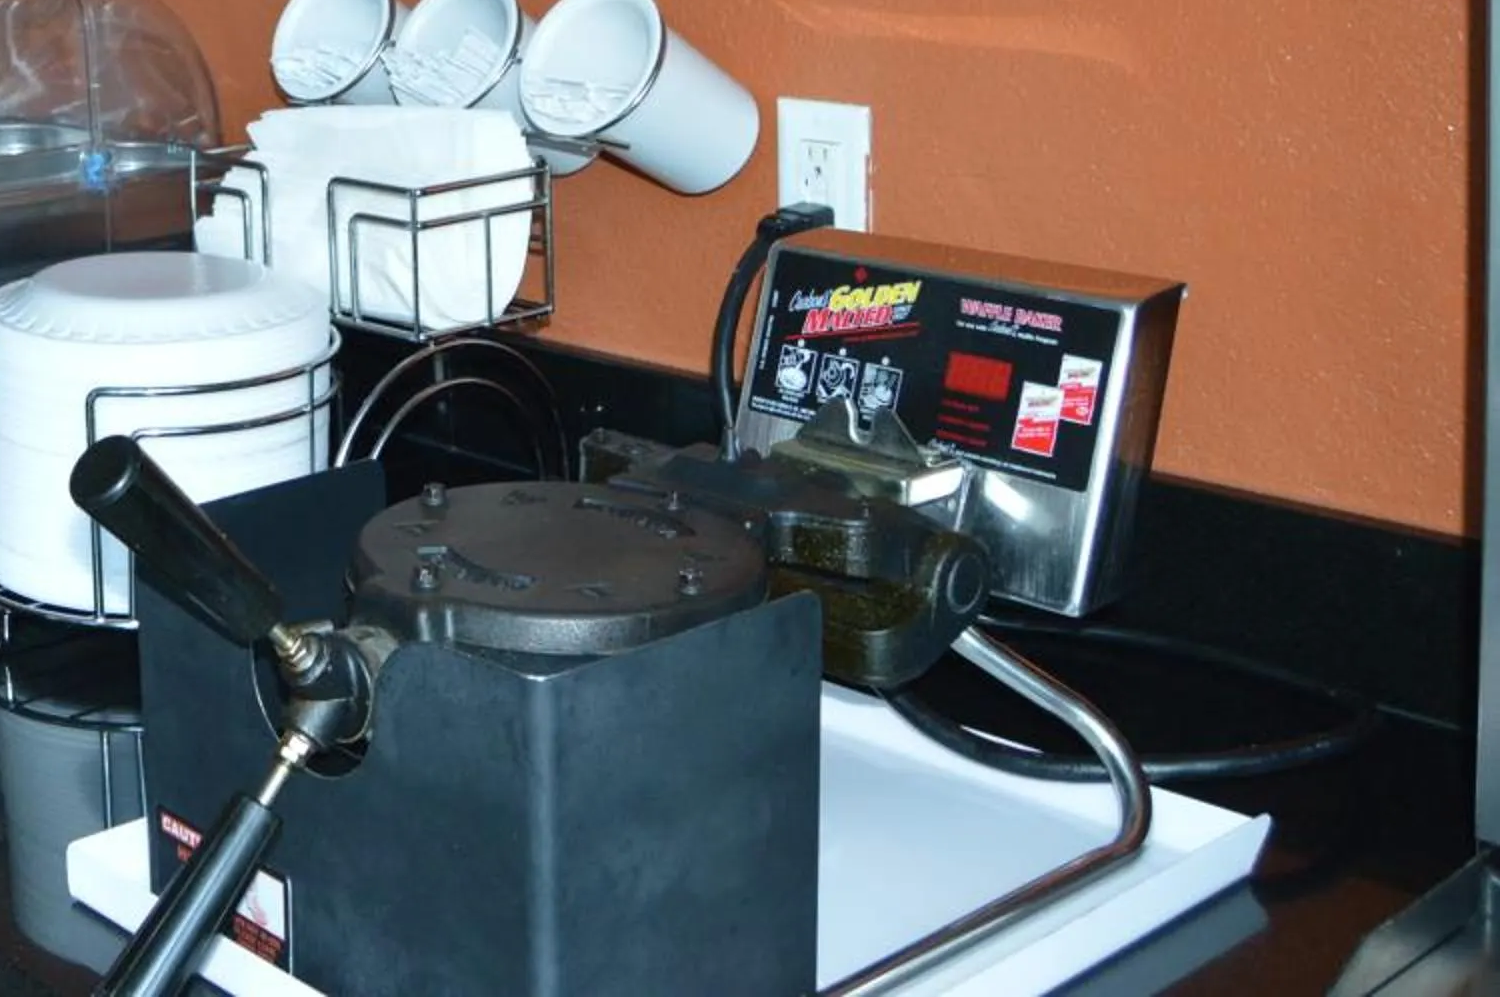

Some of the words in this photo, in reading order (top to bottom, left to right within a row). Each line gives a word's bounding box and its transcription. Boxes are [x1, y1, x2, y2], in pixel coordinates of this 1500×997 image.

[828, 280, 922, 313] GOLDEN
[801, 304, 893, 335] MALTED
[160, 811, 203, 849] CAUT
